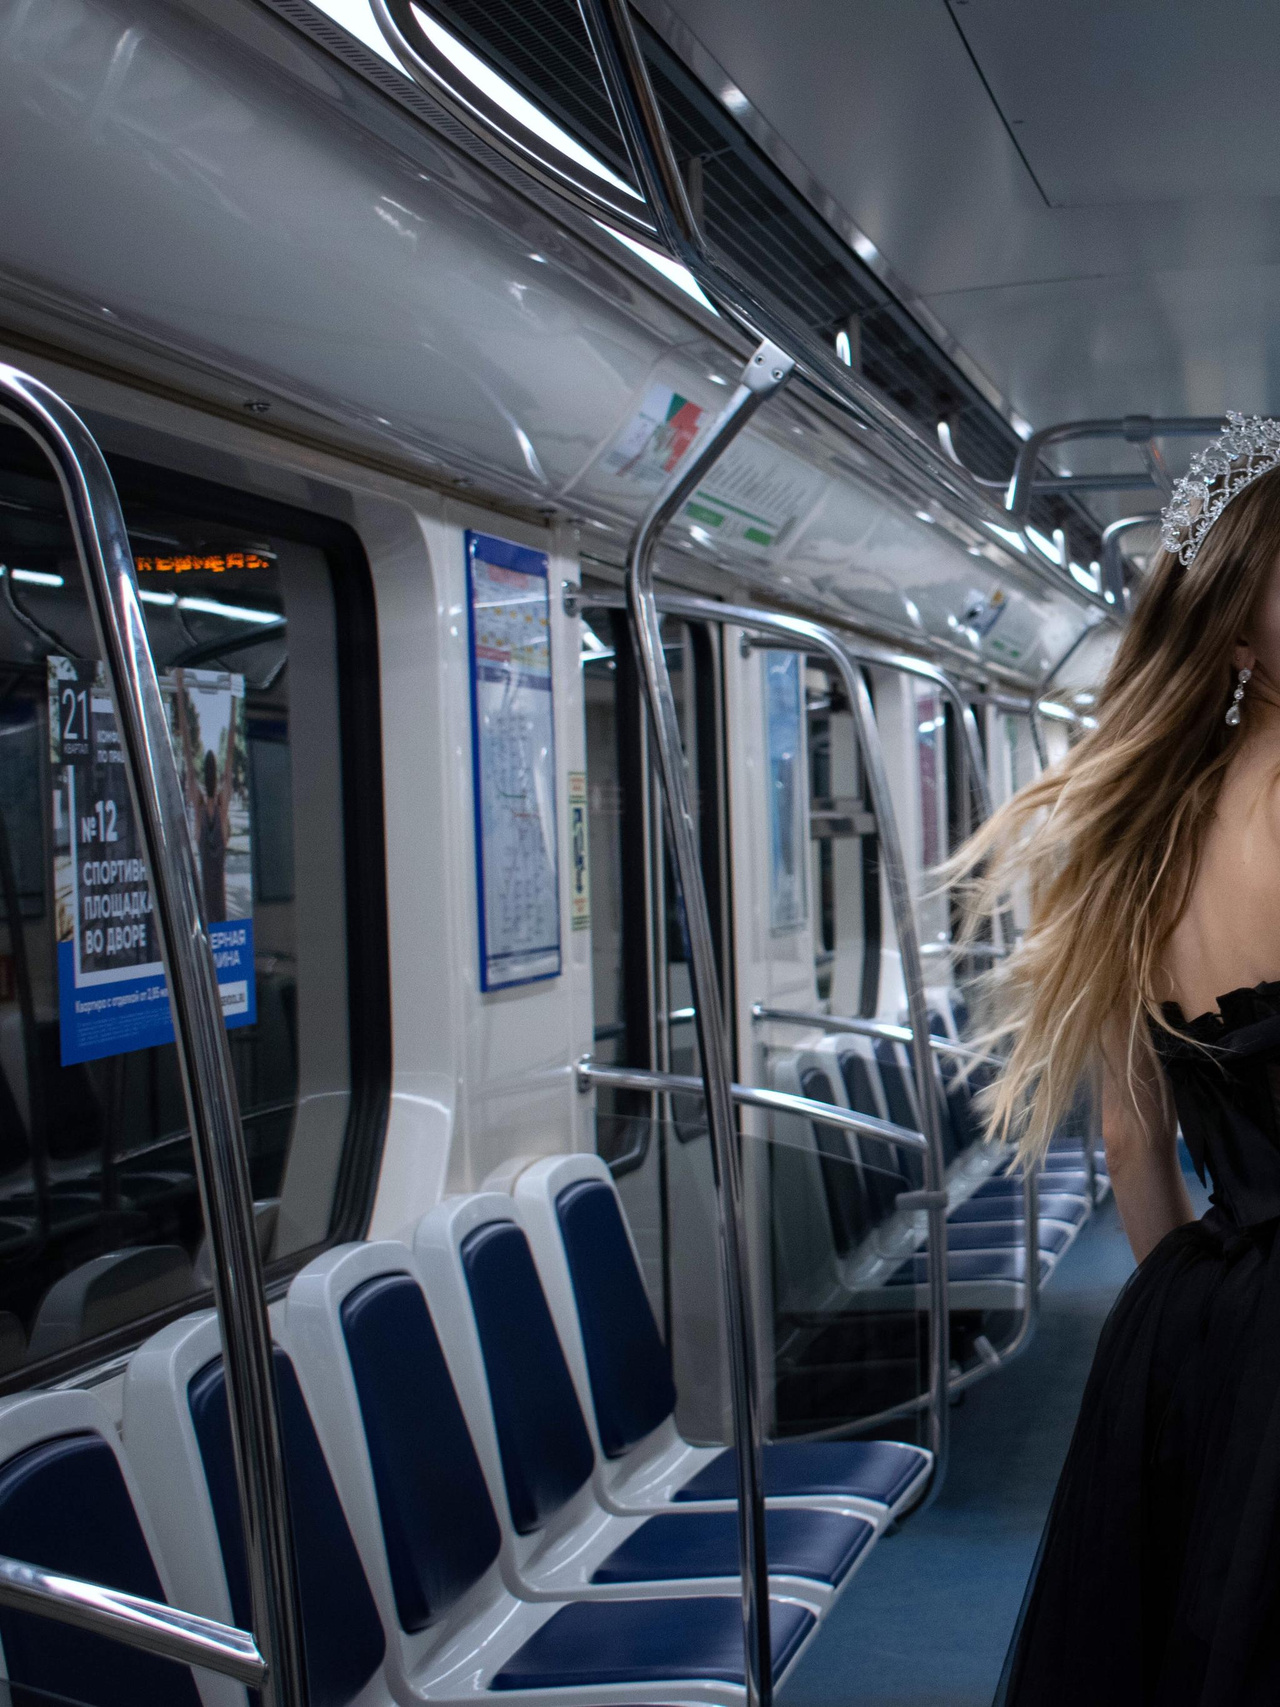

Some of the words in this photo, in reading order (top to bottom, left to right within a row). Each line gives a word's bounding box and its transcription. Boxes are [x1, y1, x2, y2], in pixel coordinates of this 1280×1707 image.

[62, 688, 88, 740] 21
[82, 858, 147, 886] СПОРТИВН
[85, 929, 104, 955] ВО
[106, 923, 147, 956] ДВОРЕ
[210, 929, 246, 949] ЕРНАЯ
[213, 950, 241, 968] ЛИНА
